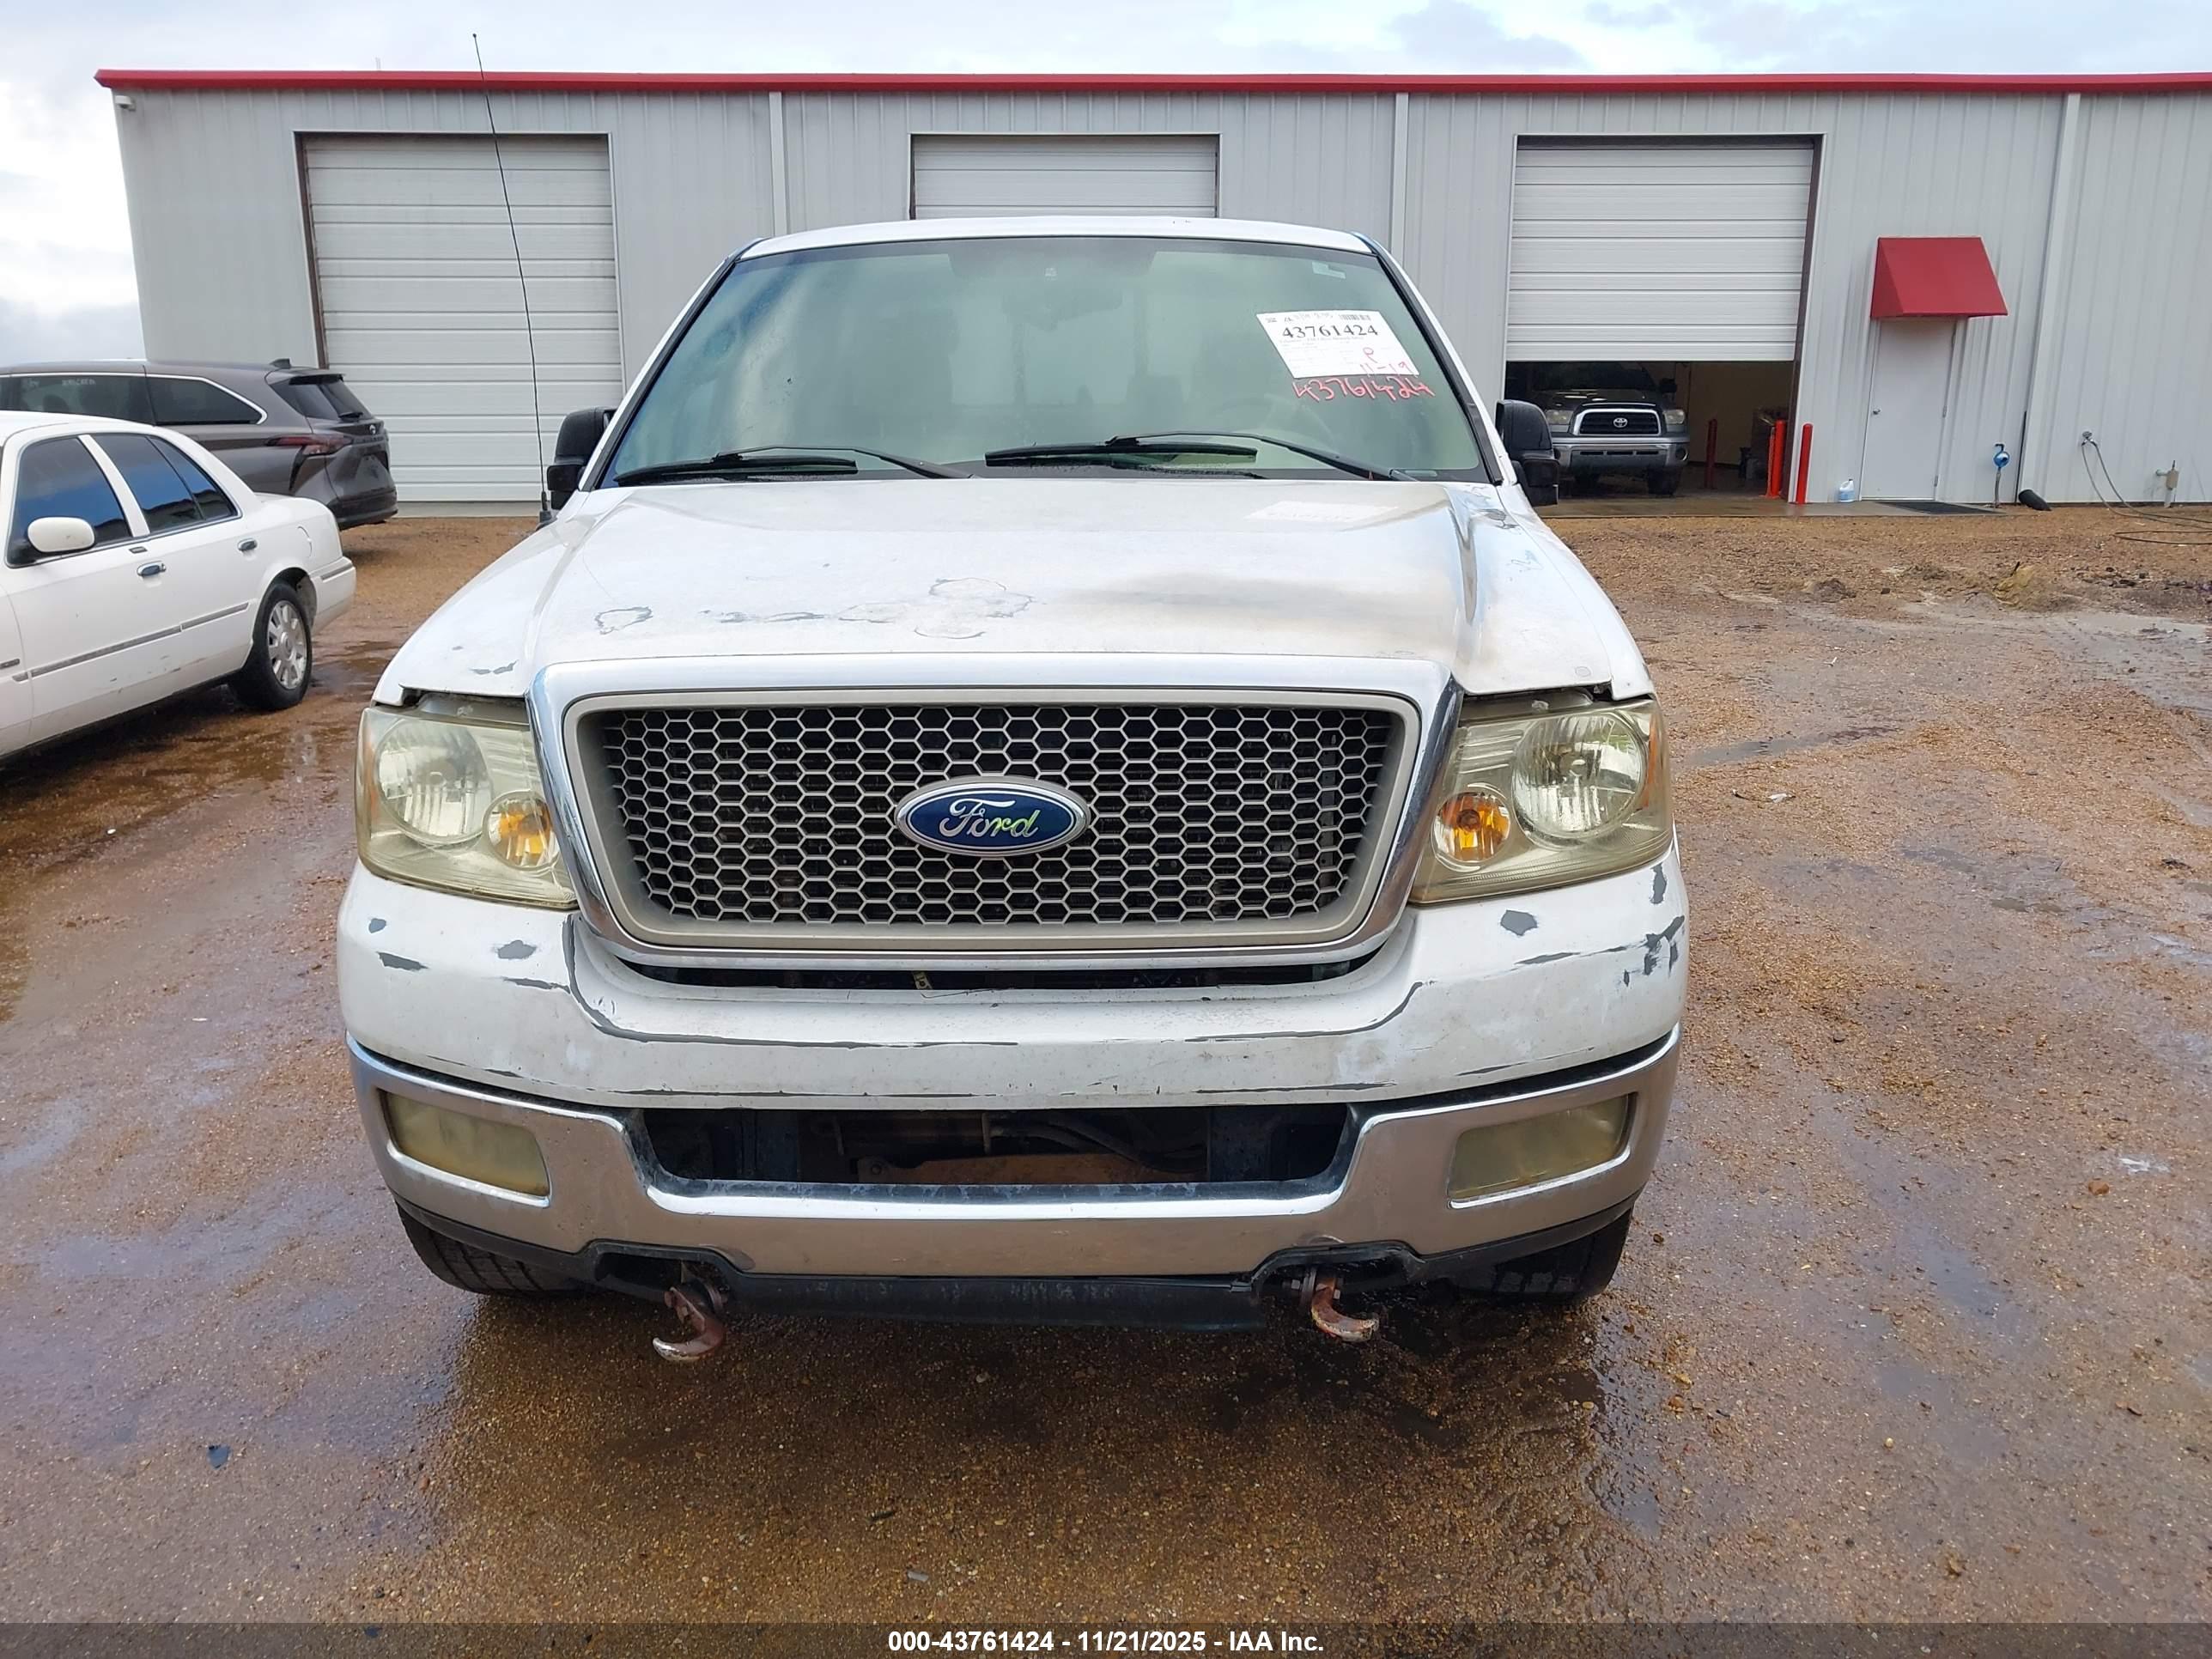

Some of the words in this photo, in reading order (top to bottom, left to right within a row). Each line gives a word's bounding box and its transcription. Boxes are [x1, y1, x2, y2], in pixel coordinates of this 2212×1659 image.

[1283, 325, 1378, 338] 43761424
[1292, 375, 1436, 402] 43761424
[939, 798, 1042, 838] Ford
